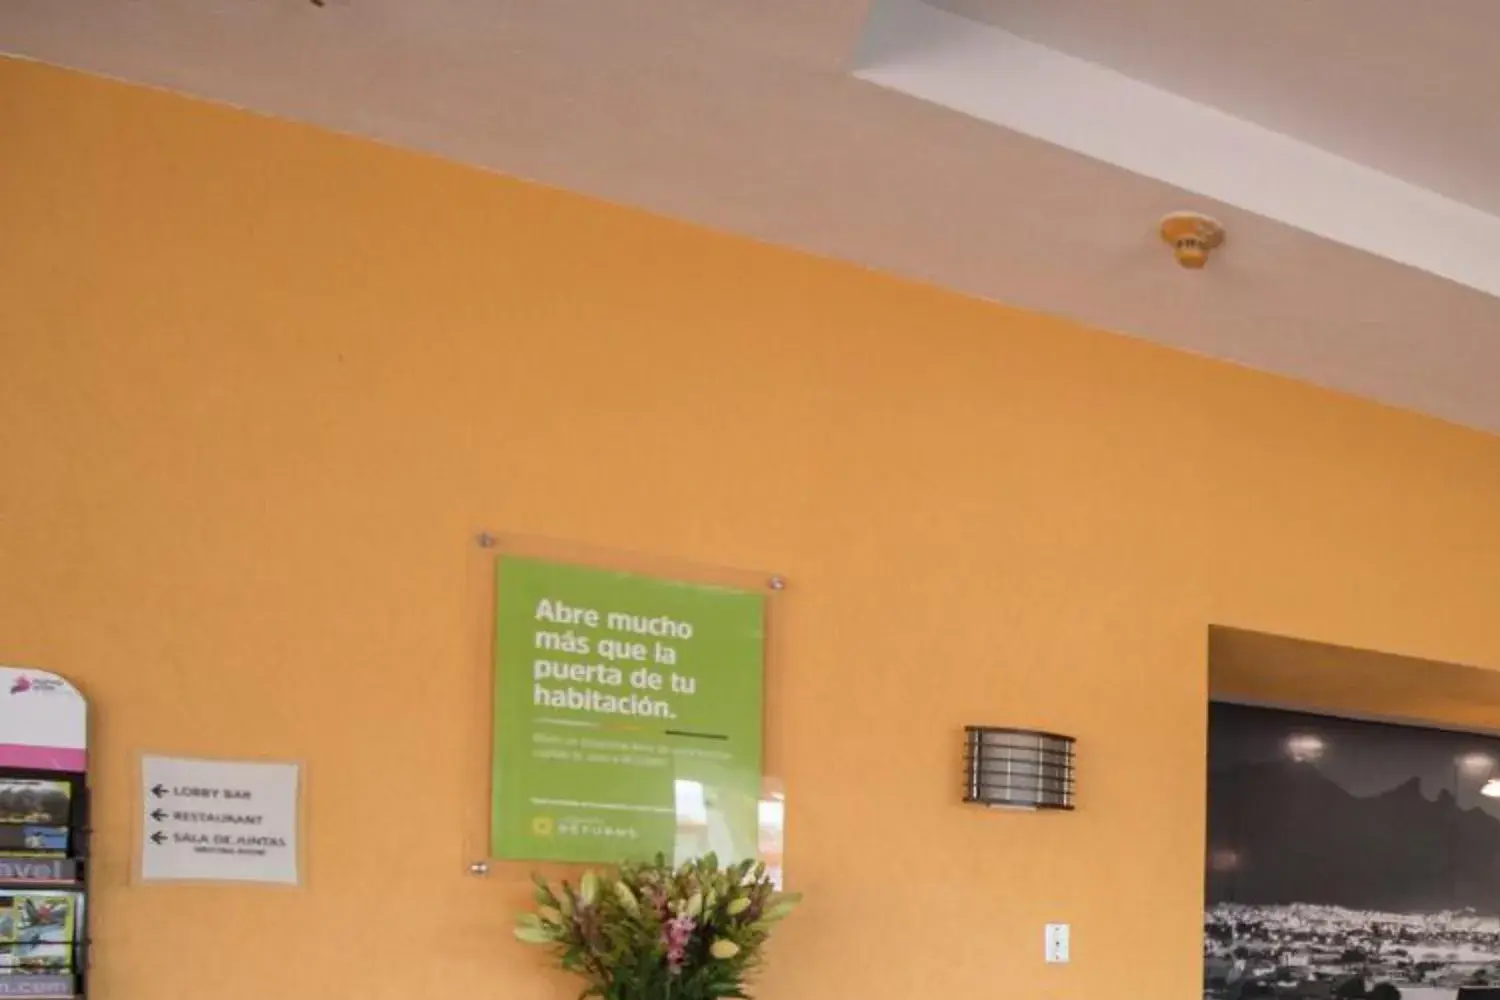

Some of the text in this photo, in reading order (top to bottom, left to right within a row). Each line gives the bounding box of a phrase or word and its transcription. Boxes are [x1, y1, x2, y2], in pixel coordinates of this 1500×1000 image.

[535, 598, 693, 640] Abre mucho
[535, 630, 676, 665] más que la
[533, 659, 696, 694] puerta de tu
[533, 683, 677, 719] habitación.
[173, 786, 252, 800] LOBBY BAR
[173, 811, 264, 825] RESTAURANT
[173, 832, 287, 847] SALA DE JUNTAS
